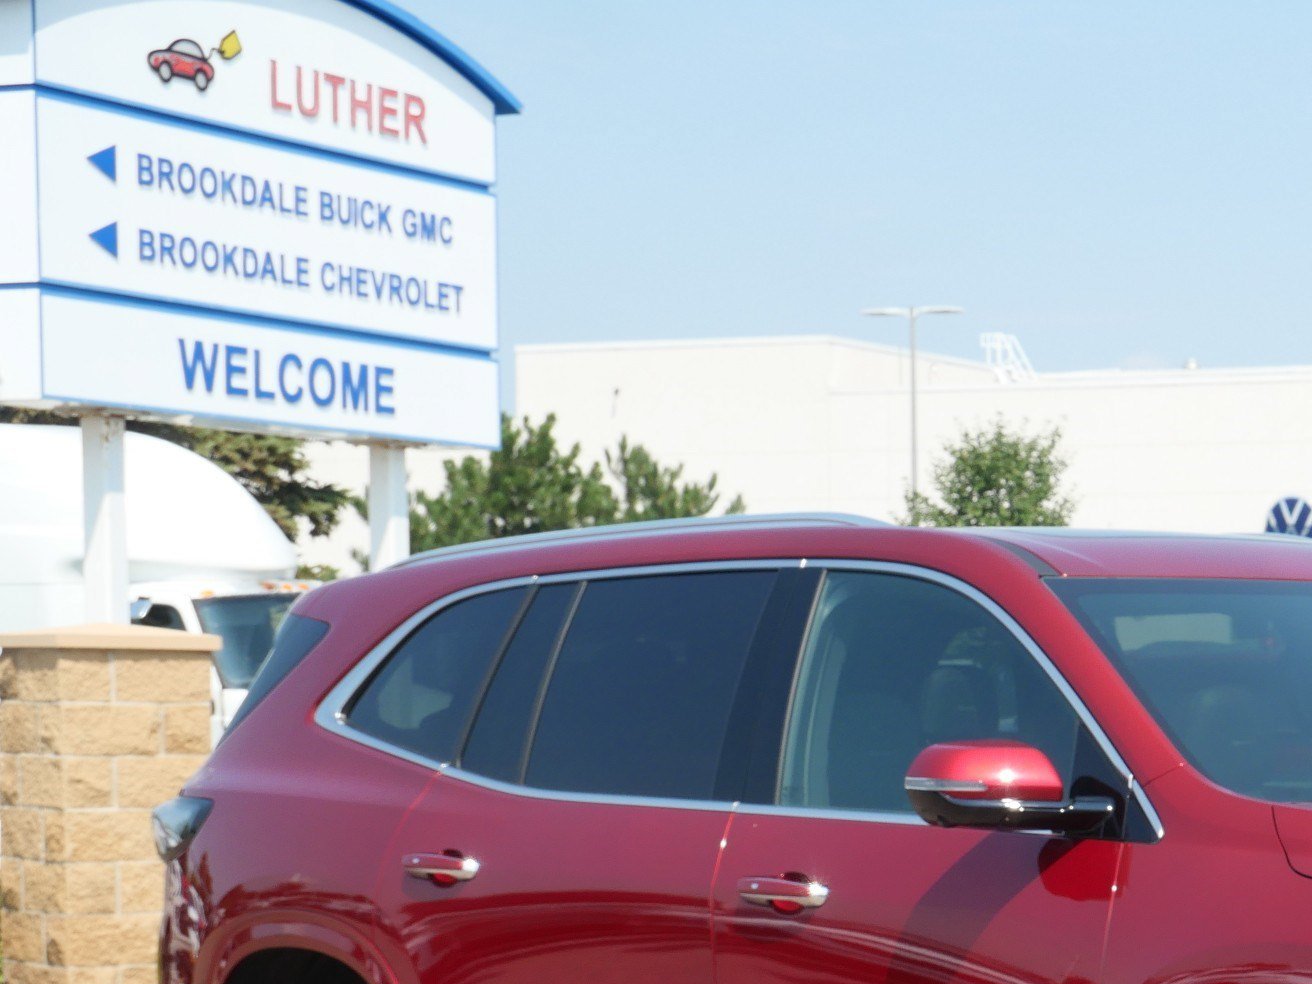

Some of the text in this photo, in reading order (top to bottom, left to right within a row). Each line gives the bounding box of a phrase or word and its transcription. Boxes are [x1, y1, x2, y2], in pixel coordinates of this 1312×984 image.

[270, 59, 428, 144] LUTHER
[137, 153, 453, 245] BROOKDALE BUICK GMC
[139, 229, 464, 314] BROOKDALE CHEVROLET
[178, 338, 396, 414] WELCOME
